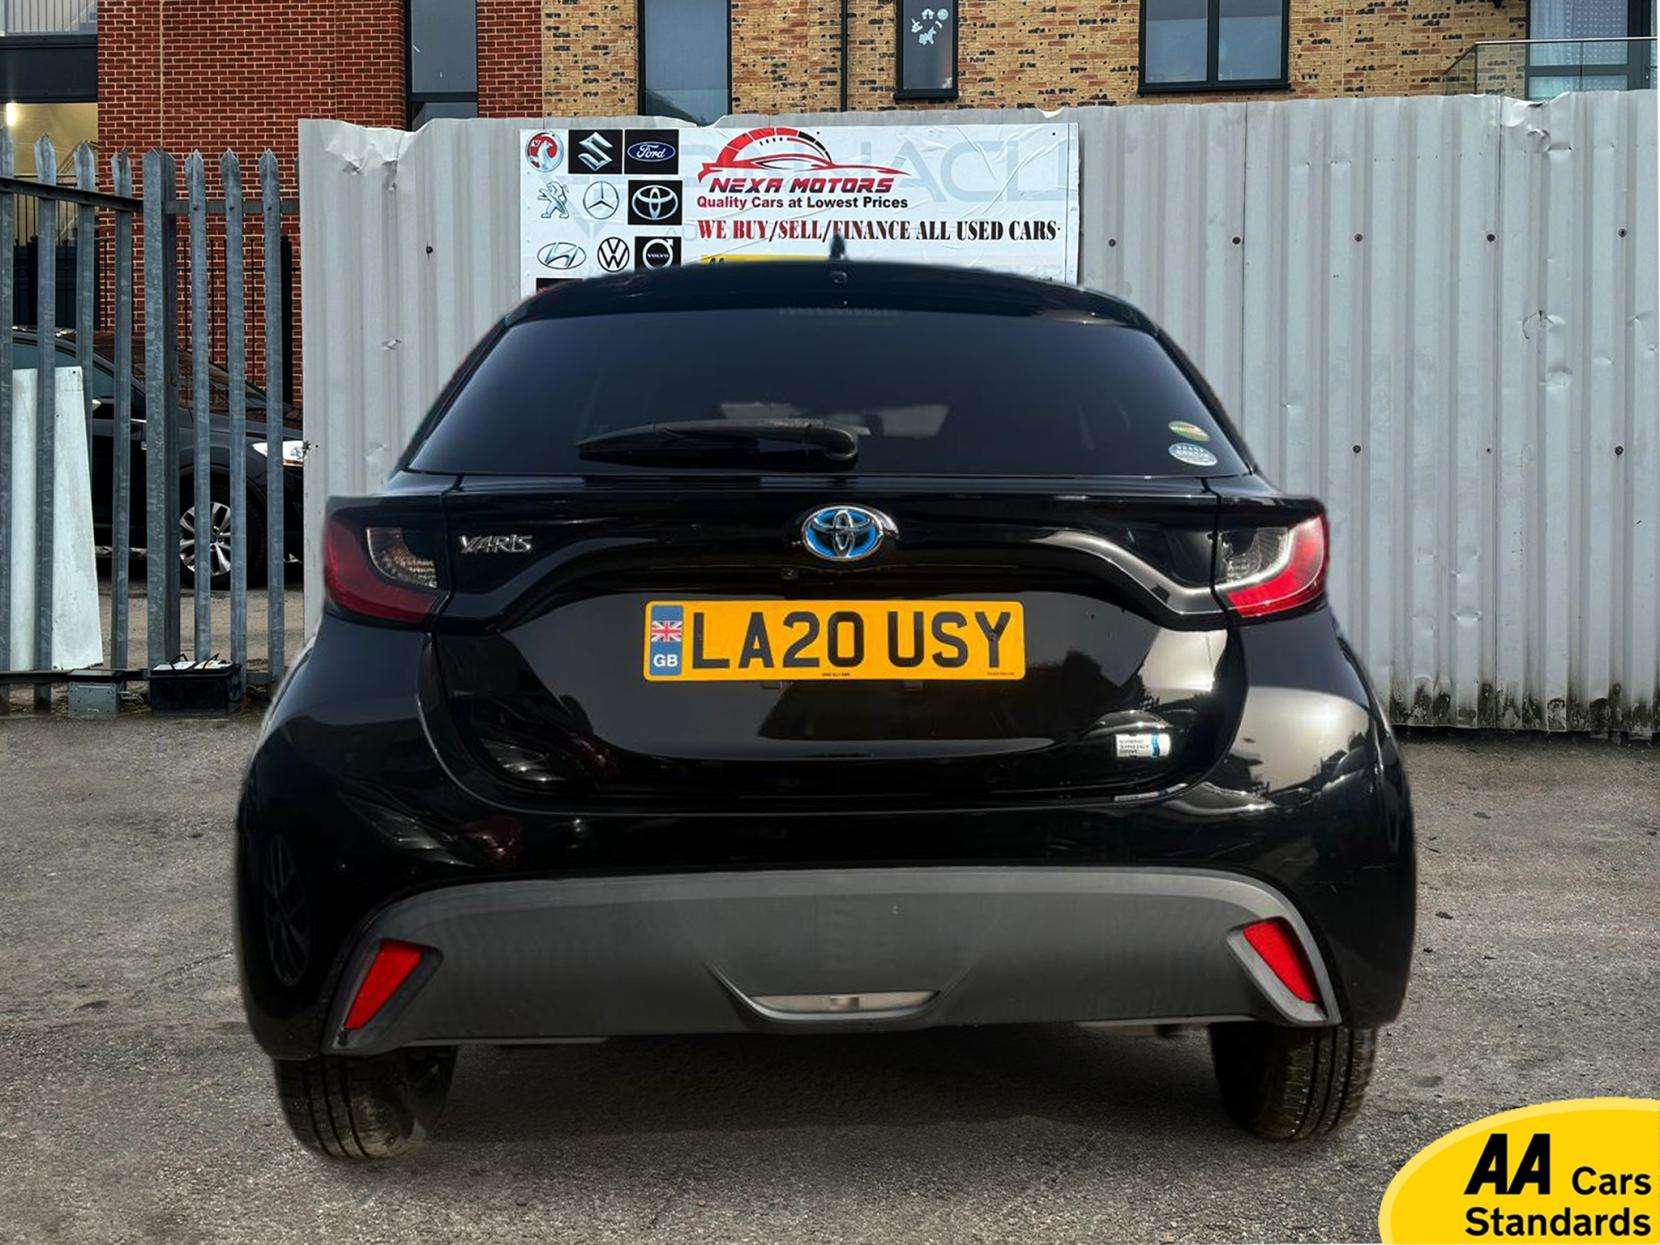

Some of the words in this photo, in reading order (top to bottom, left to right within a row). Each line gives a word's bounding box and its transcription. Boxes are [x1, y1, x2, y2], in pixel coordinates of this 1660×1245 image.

[635, 144, 666, 159] Ford
[709, 178, 783, 193] NEXA
[789, 178, 894, 194] MOTORS
[697, 196, 747, 210] Quality
[751, 196, 784, 208] Cars
[788, 197, 803, 208] at
[807, 197, 859, 208] Lowest
[862, 196, 908, 209] Prices
[698, 220, 727, 239] WE
[916, 221, 950, 240] ALL
[956, 220, 1004, 241] USED
[459, 534, 533, 554] YARIS
[692, 610, 865, 669] LA20
[887, 610, 1012, 669] USY
[652, 653, 679, 668] GB
